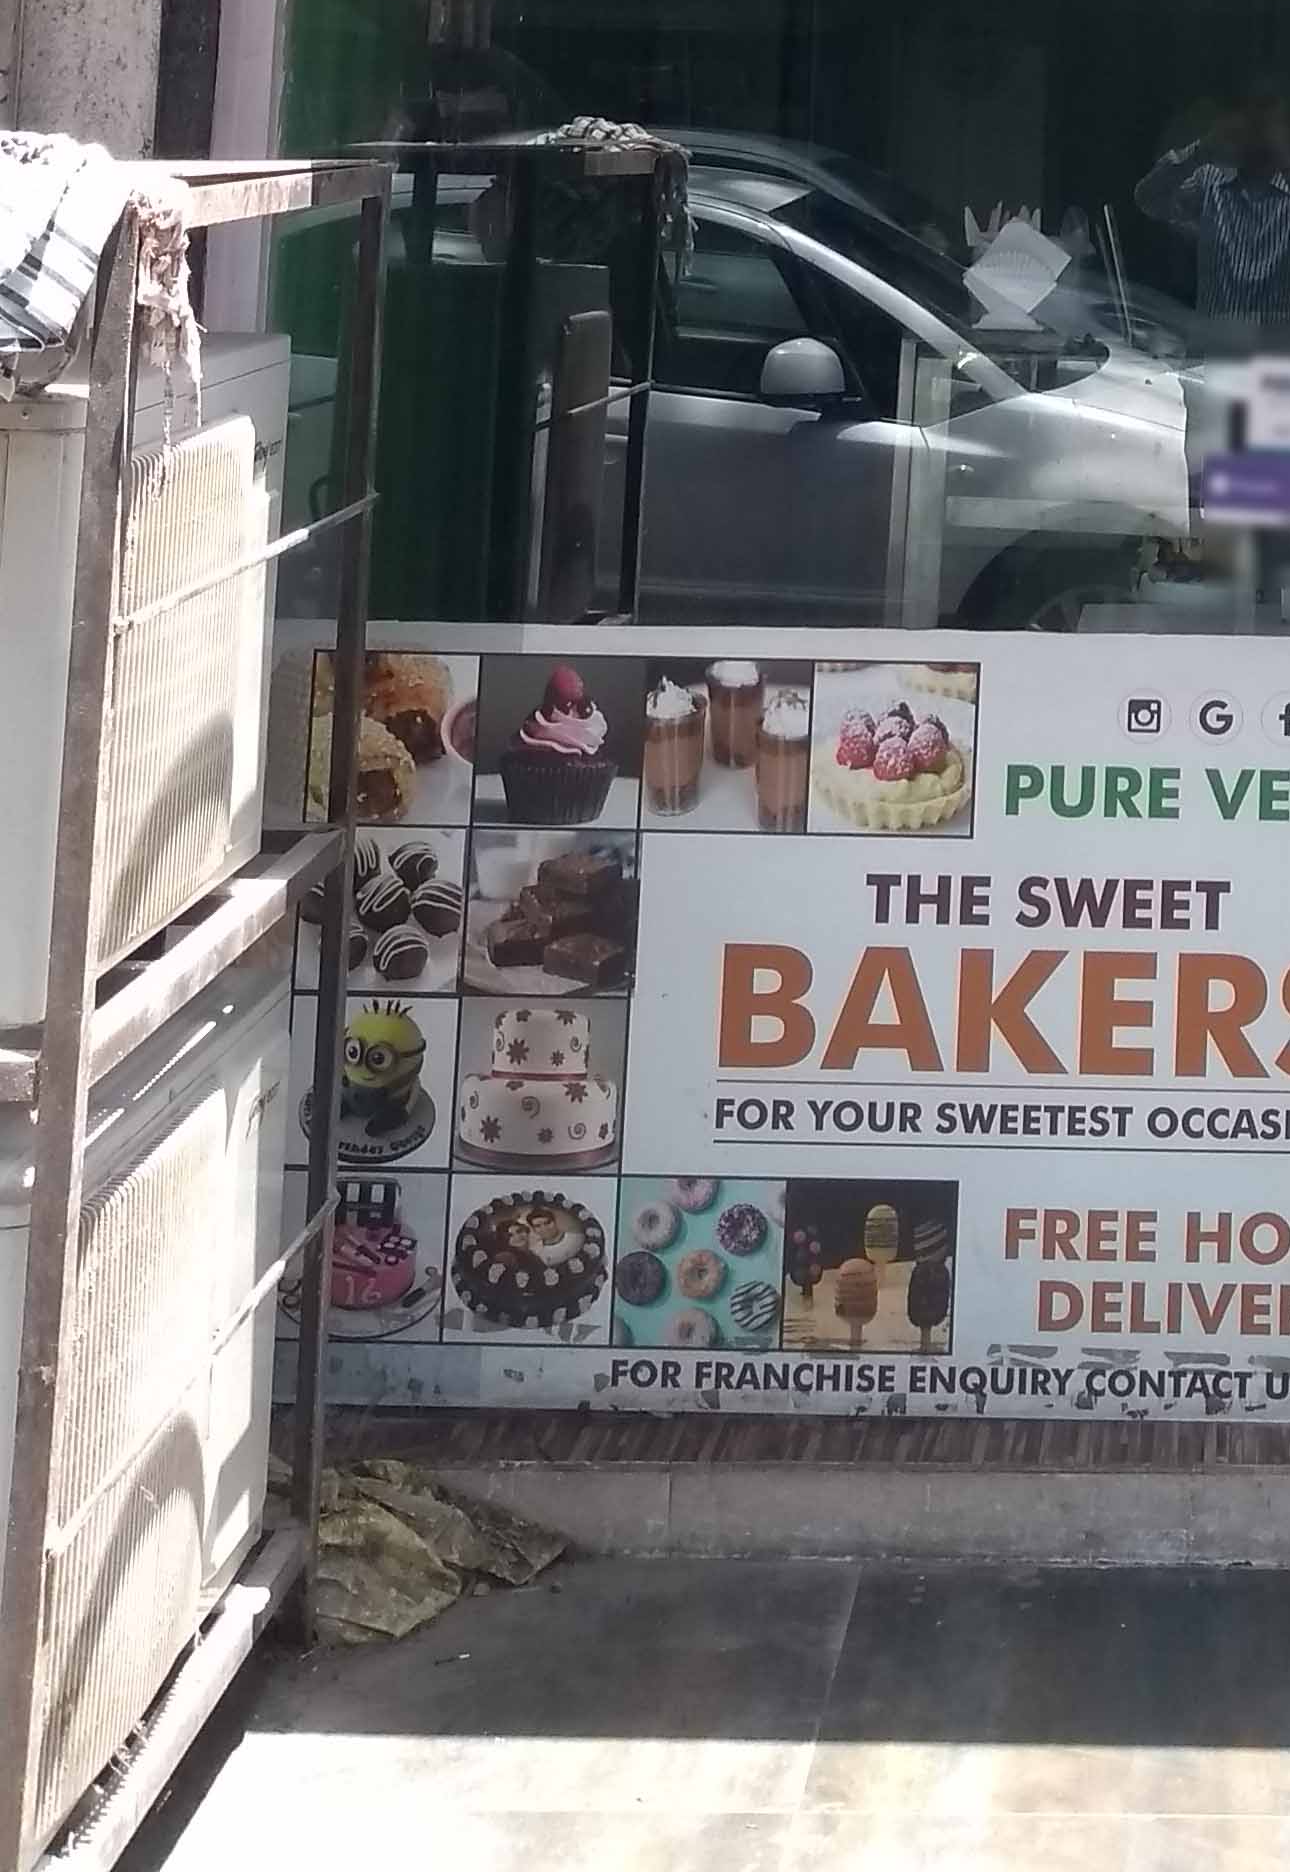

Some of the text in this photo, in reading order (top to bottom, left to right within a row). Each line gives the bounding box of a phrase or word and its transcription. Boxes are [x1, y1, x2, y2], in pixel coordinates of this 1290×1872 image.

[1004, 763, 1182, 820] PURE
[866, 873, 1232, 931] THE SWEET
[714, 1097, 795, 1131] FOR
[806, 1099, 922, 1135] YOUR
[935, 1101, 1134, 1139] SWEETEST
[1003, 1207, 1159, 1264] FREE
[611, 1358, 683, 1392] FOR
[694, 1360, 897, 1396] FRANCHISE
[908, 1362, 1073, 1399] ENQUIRY
[1085, 1366, 1253, 1402] CONTACT
